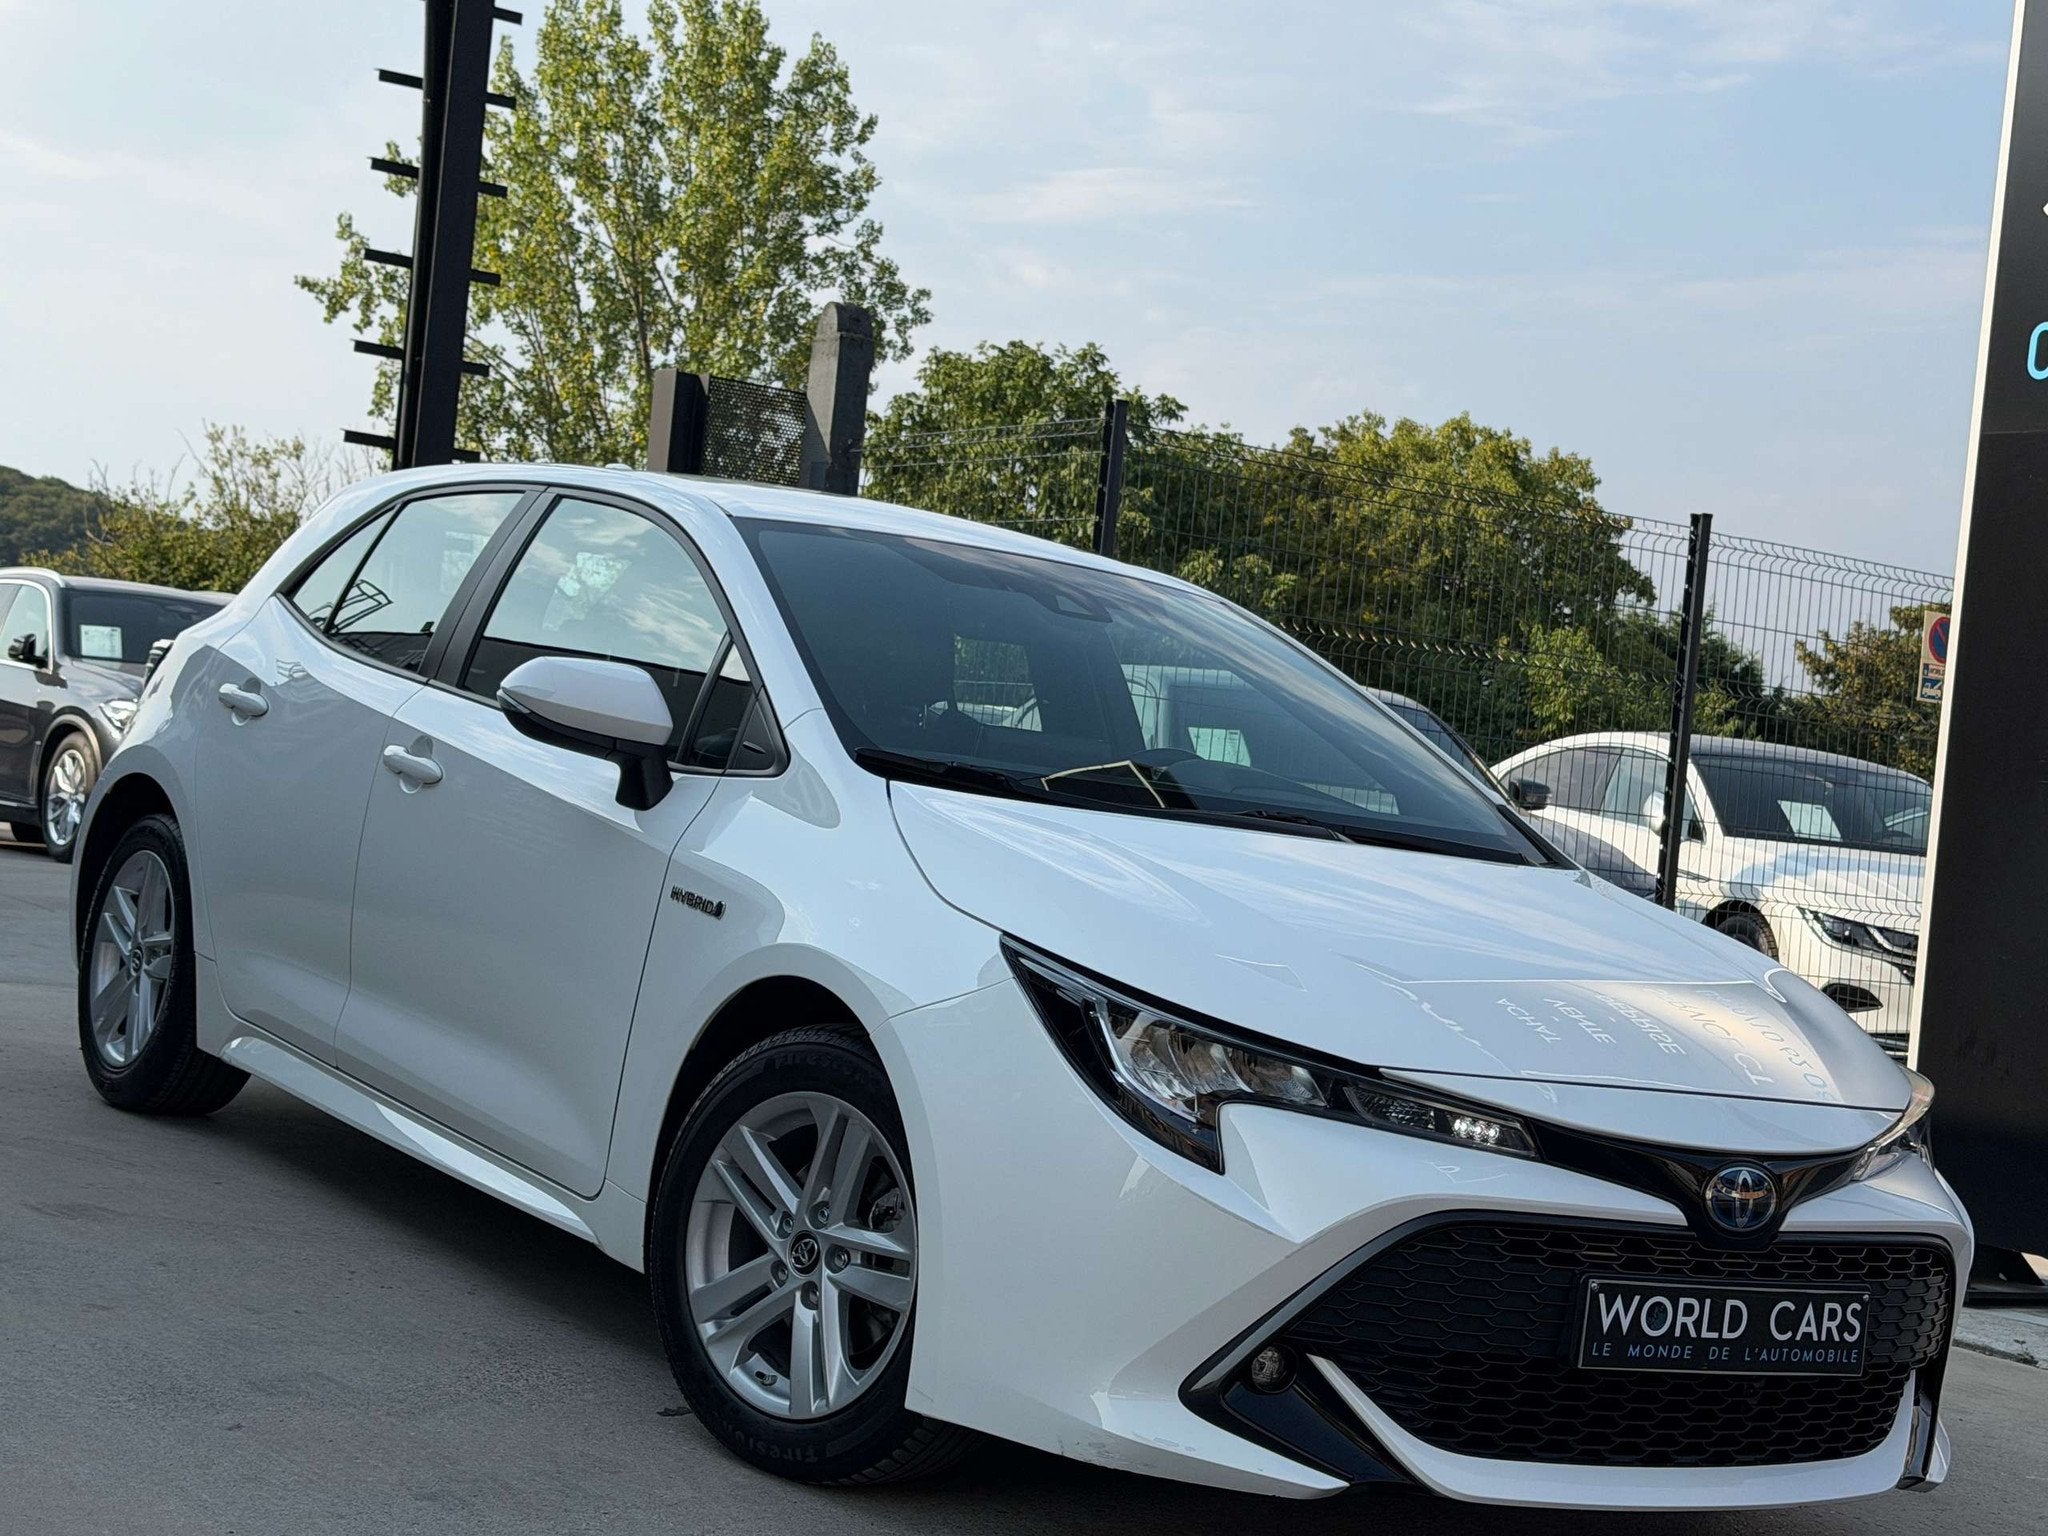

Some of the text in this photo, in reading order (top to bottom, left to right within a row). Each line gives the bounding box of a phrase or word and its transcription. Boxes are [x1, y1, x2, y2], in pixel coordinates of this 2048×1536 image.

[671, 885, 715, 915] HYBRID
[1599, 1292, 1863, 1343] WORLD CARS
[1592, 1342, 1859, 1364] LE MONDE DE L'AUTOMOBILE
